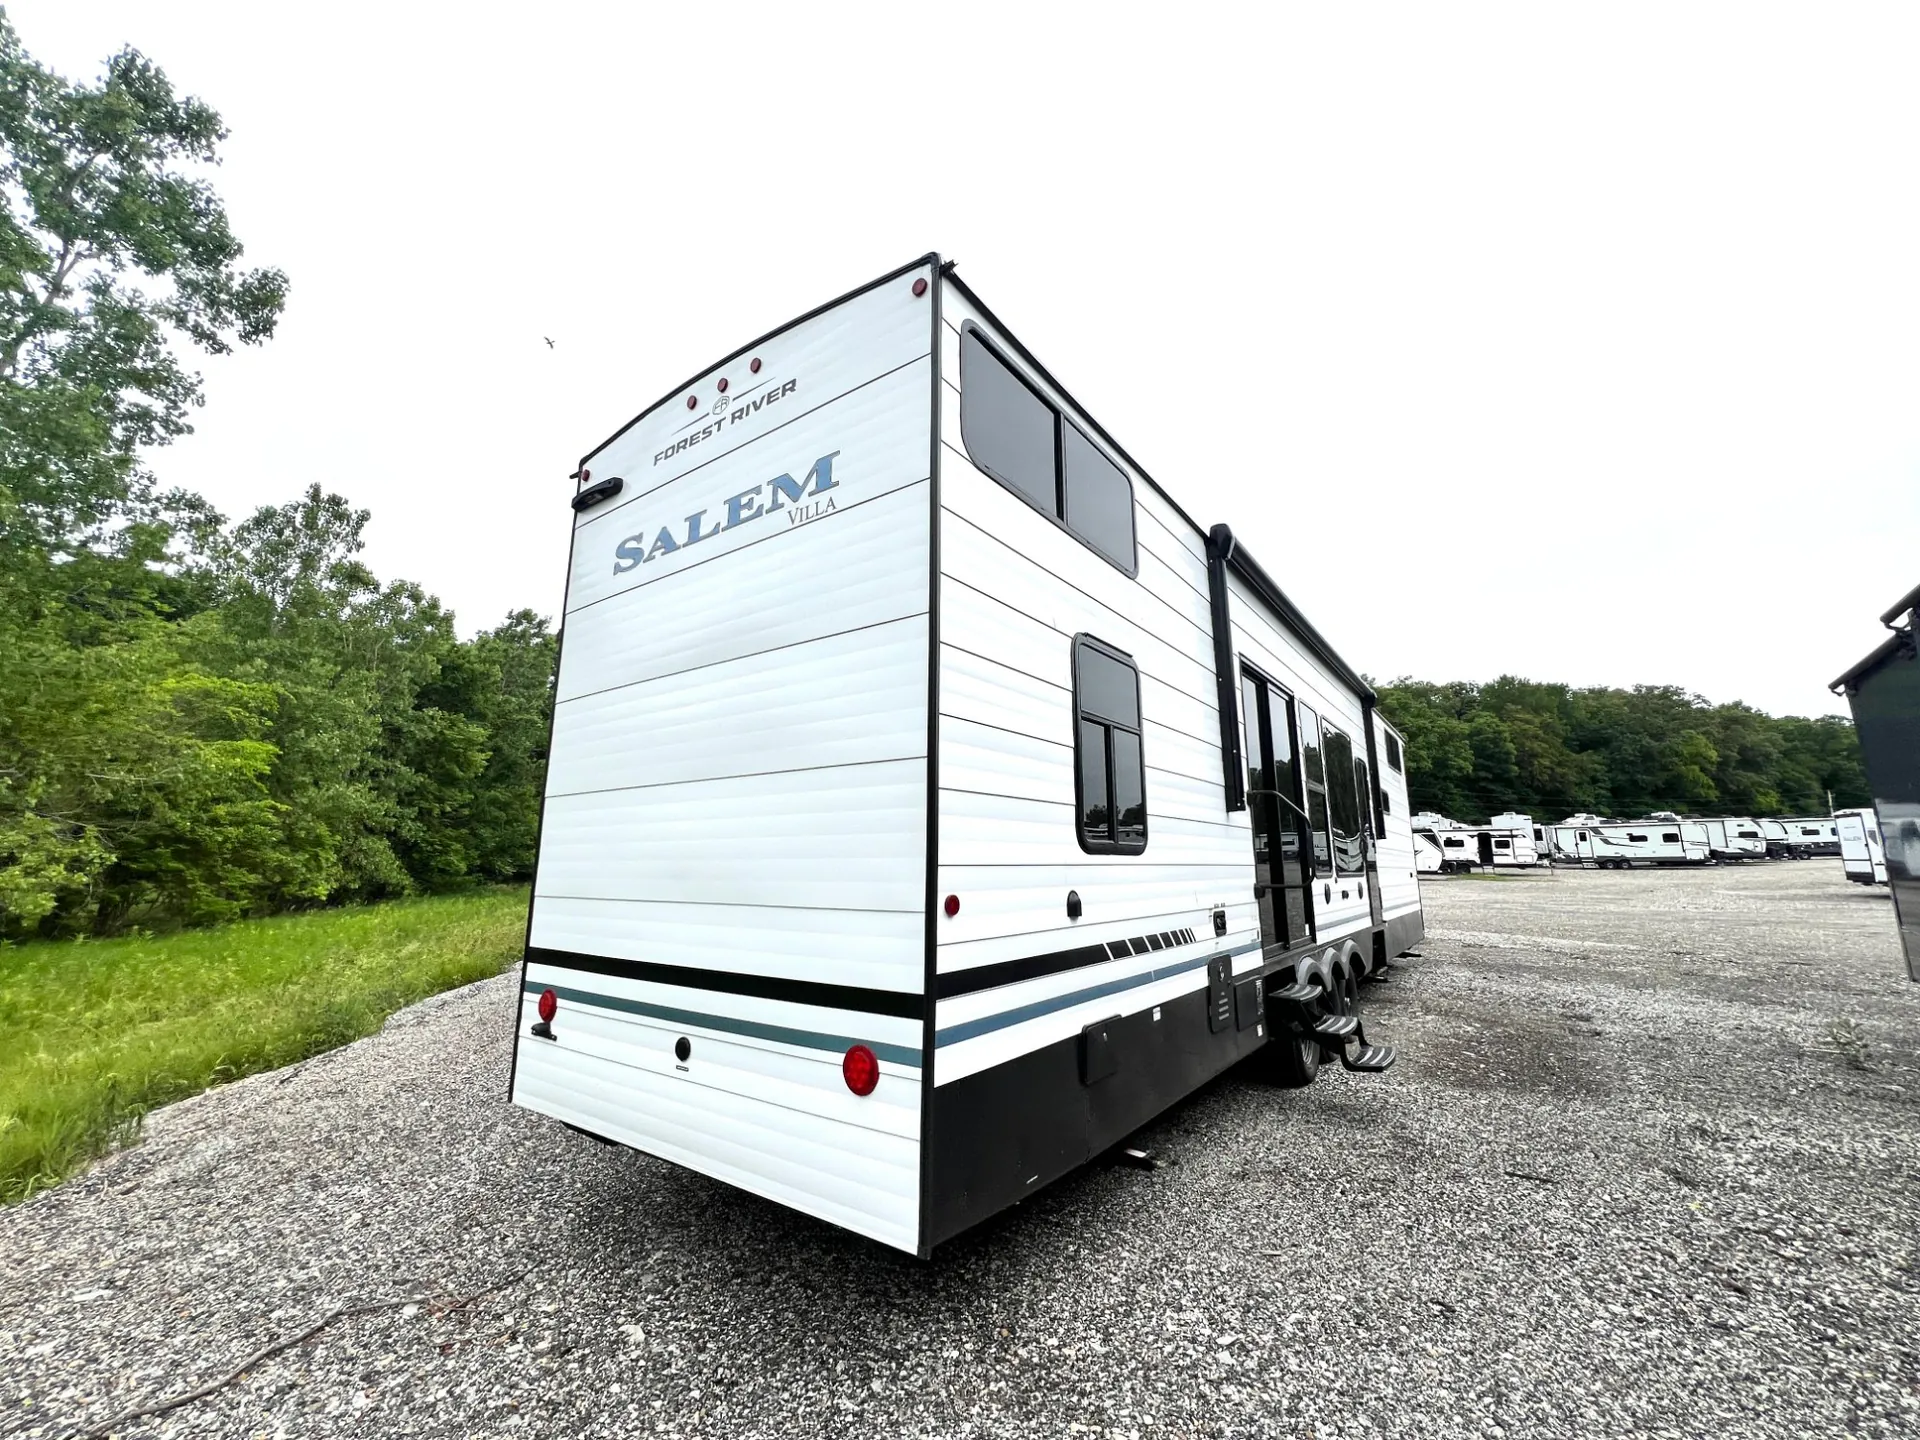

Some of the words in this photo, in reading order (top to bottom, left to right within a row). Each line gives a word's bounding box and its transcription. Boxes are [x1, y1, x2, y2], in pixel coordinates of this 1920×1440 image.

[653, 417, 727, 467] FOREST
[730, 378, 797, 425] RIVER
[613, 450, 841, 577] SALEM
[787, 496, 837, 526] VILLA
